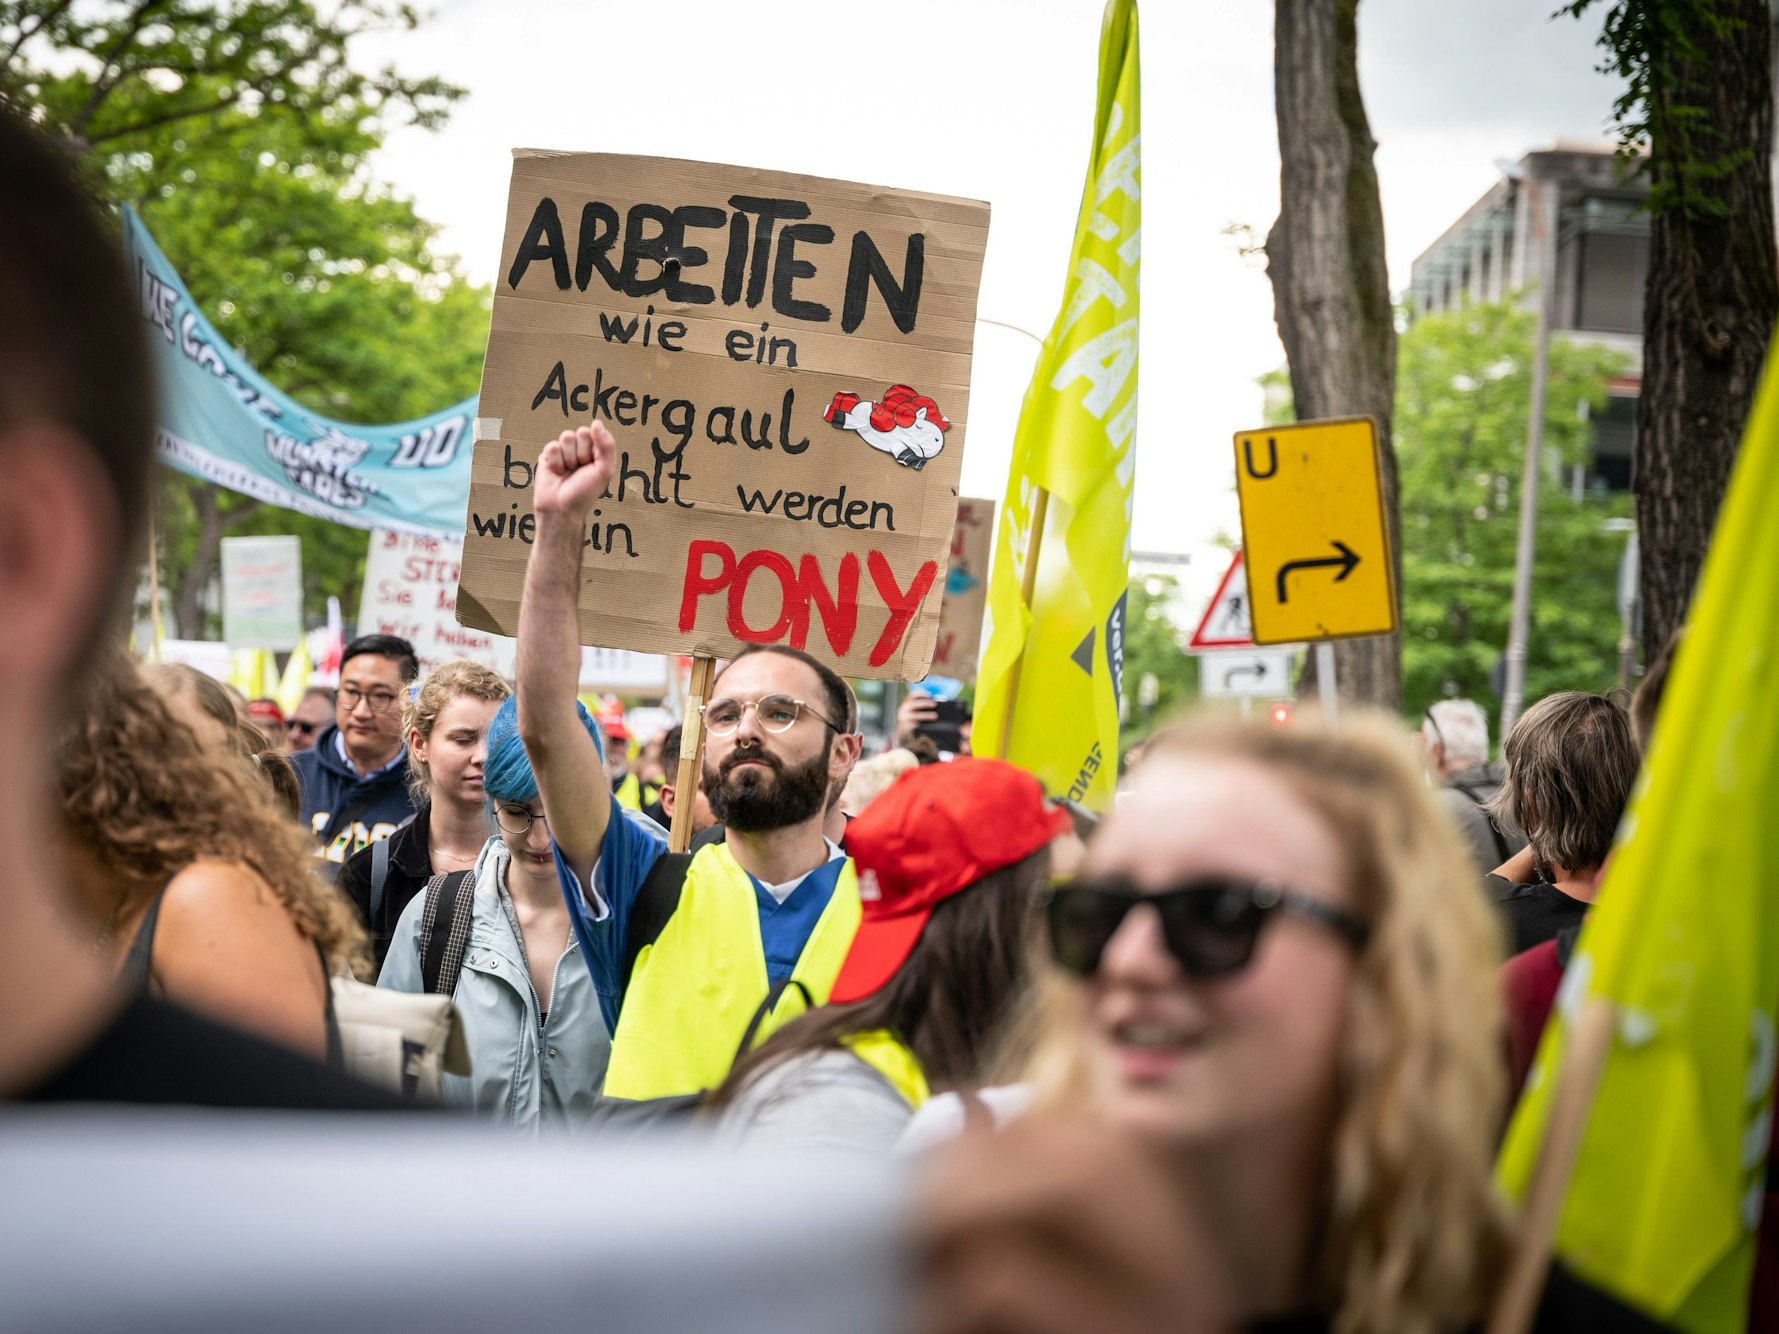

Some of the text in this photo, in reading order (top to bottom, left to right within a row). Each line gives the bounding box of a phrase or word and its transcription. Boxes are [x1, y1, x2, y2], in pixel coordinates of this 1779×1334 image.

[508, 195, 926, 335] ARBEITEN
[599, 304, 798, 369] wie ein
[531, 360, 810, 463] Ackergaul
[503, 444, 695, 509] bhlt
[736, 483, 896, 533] werden
[1243, 437, 1278, 480] U
[472, 503, 536, 545] wie
[584, 508, 640, 558] in
[678, 538, 938, 668] PONY
